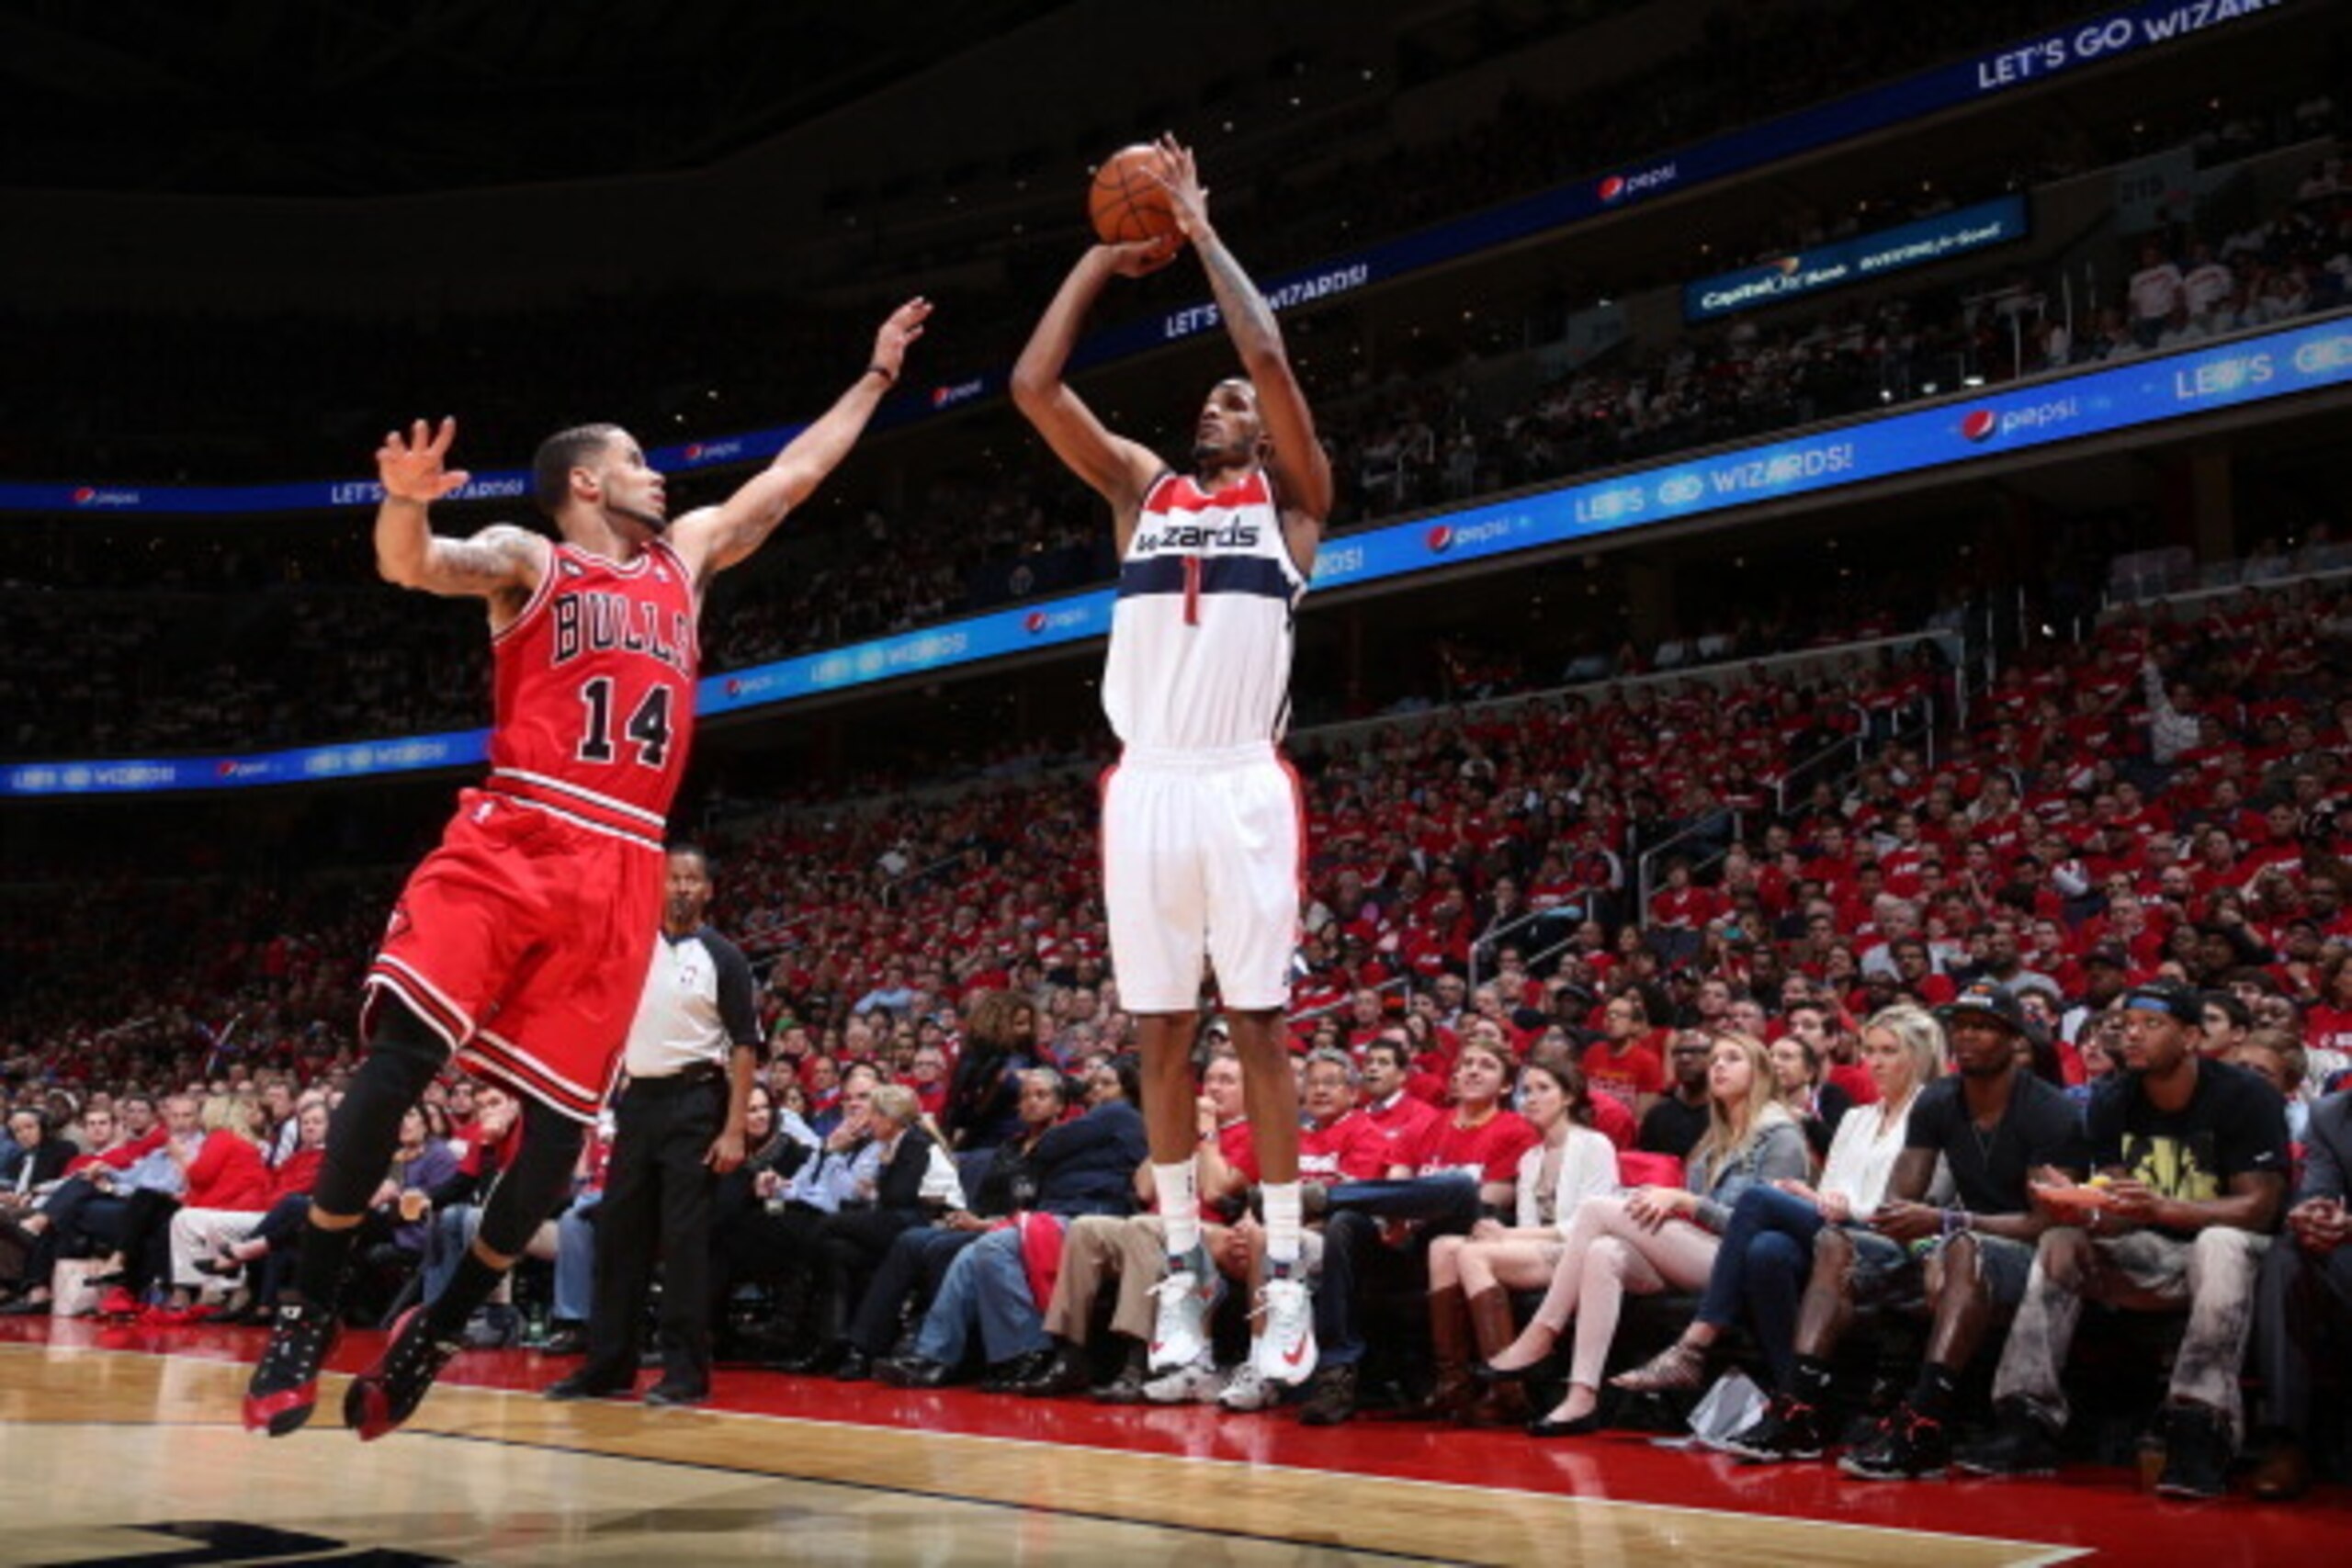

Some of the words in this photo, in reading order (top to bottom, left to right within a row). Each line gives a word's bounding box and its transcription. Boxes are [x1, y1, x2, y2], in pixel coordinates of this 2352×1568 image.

[1978, 38, 2065, 89] LET'S
[2074, 17, 2133, 57] GO
[1266, 264, 1368, 310] WIZARDS!
[2003, 397, 2078, 434] pepsi
[1181, 555, 1201, 626] 1
[574, 675, 674, 772] 14
